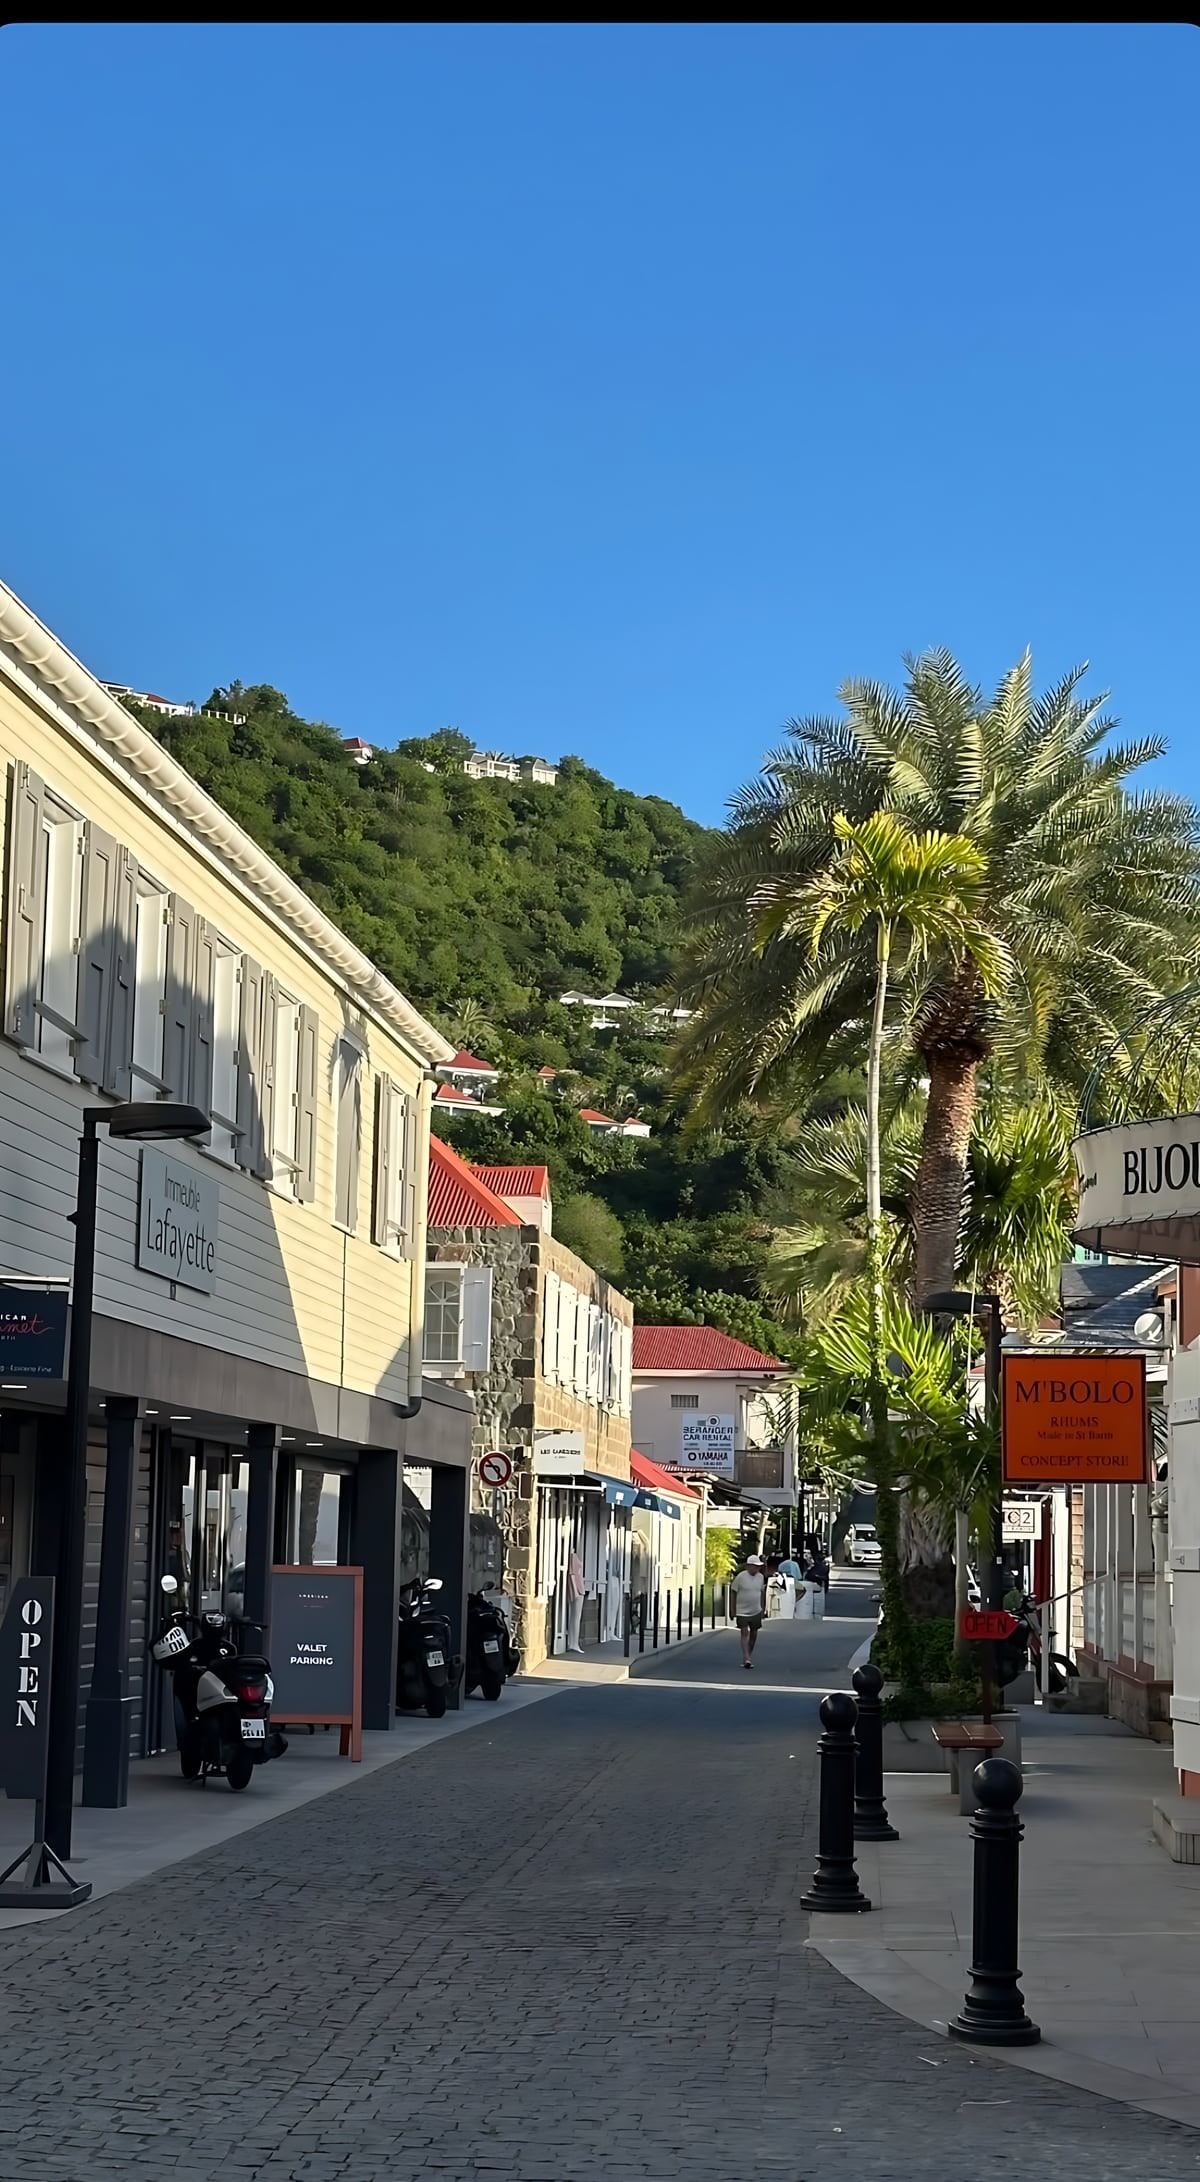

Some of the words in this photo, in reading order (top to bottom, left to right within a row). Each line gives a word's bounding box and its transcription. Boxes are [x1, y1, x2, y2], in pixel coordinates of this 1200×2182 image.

[164, 1165, 200, 1212] Immeuble
[147, 1198, 215, 1277] Lafayette
[1015, 1380, 1134, 1405] M'BOLO
[1050, 1416, 1099, 1428] RHUMS
[682, 1426, 733, 1434] BERANGER
[1038, 1431, 1062, 1440] Made
[1075, 1430, 1086, 1440] St
[1088, 1430, 1113, 1440] Barth
[698, 1452, 728, 1461] YAMAHA
[1020, 1455, 1082, 1467] CONCEPT
[1086, 1455, 1129, 1467] STORE
[965, 1614, 1007, 1634] OPEN
[297, 1643, 328, 1652] VALET
[16, 1599, 42, 1727] OPEN
[290, 1656, 334, 1665] PARKING
